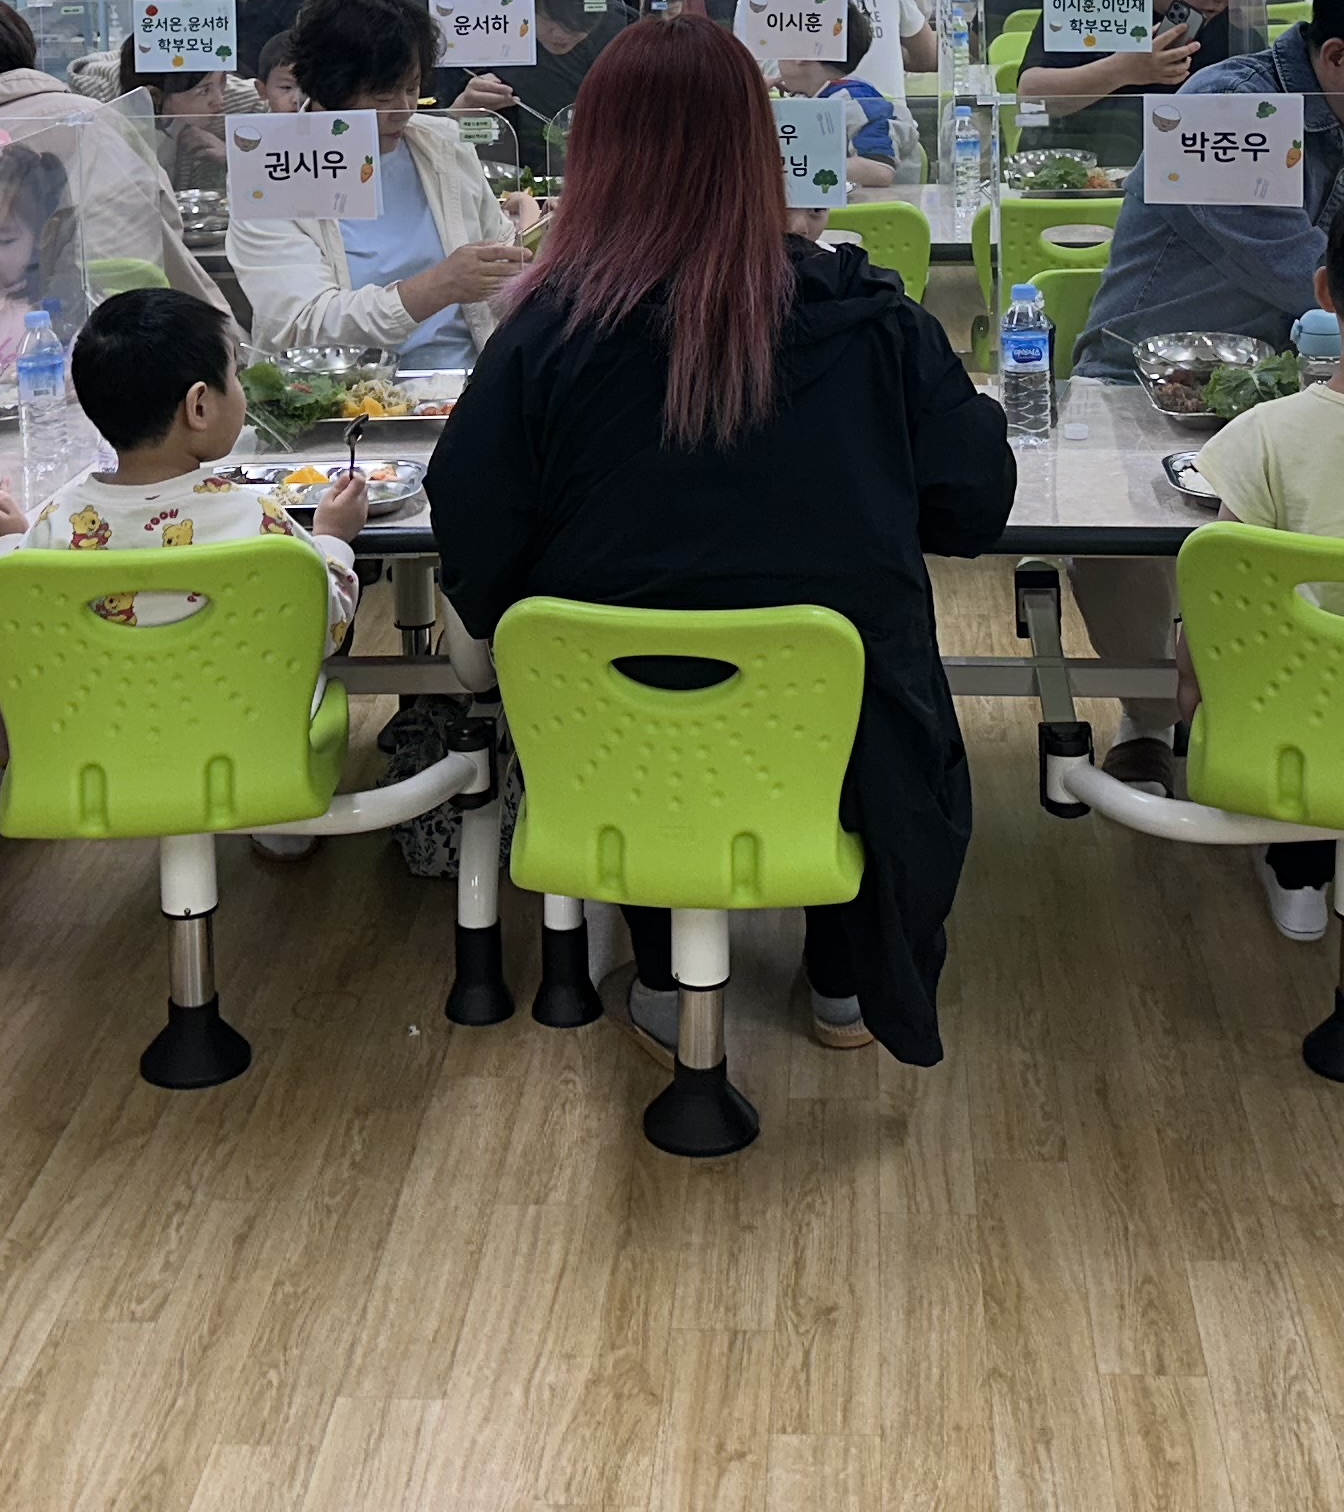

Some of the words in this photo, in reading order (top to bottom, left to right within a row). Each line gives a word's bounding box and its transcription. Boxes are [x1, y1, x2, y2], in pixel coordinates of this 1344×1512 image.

[453, 14, 509, 36] 윤서하
[766, 11, 823, 33] 이시훈
[1069, 18, 1127, 35] 학부모님
[157, 37, 213, 53] 학부모님
[1181, 131, 1270, 163] 박준우
[264, 149, 348, 181] 권시우
[143, 508, 179, 531] POOH
